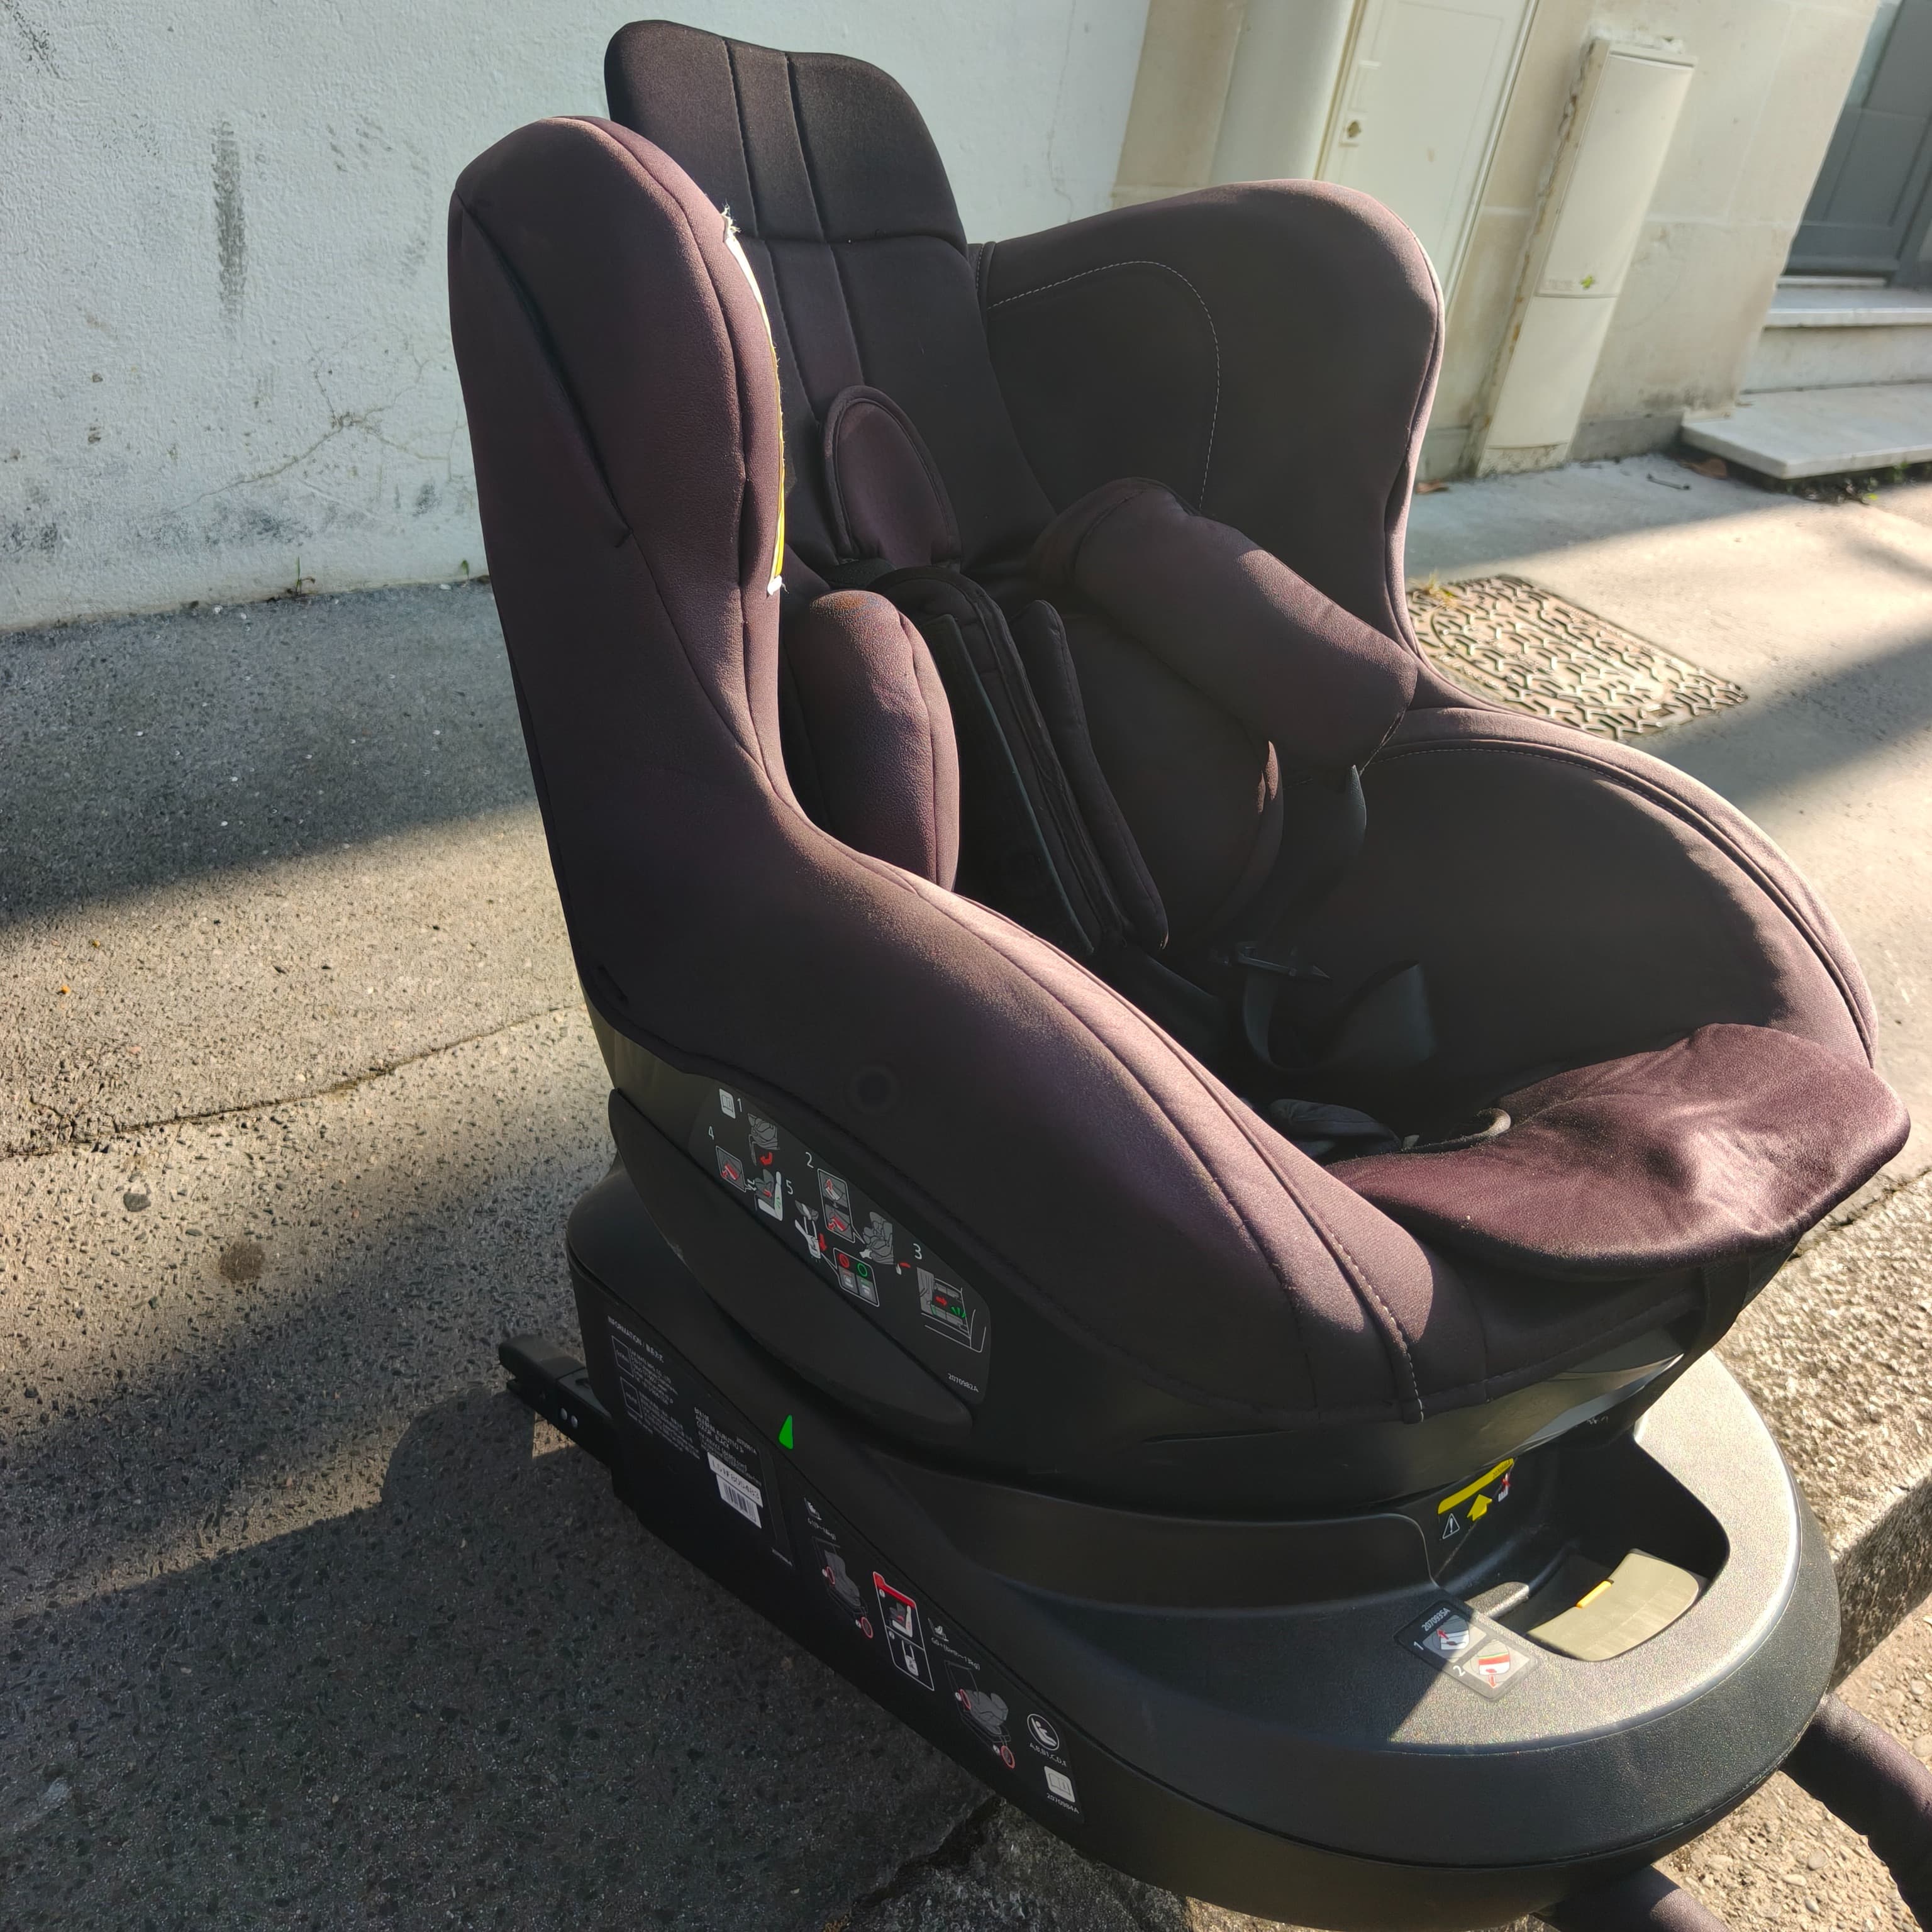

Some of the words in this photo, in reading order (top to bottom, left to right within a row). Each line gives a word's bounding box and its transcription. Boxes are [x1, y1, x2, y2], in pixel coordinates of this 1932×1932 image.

[737, 1097, 743, 1112] 1
[708, 1126, 715, 1140] 4
[805, 1152, 814, 1169] 2
[786, 1180, 794, 1195] 5
[913, 1243, 923, 1260] 3
[1421, 1607, 1451, 1632] 2070935A
[1413, 1641, 1424, 1651] 1
[1452, 1665, 1466, 1677] 2
